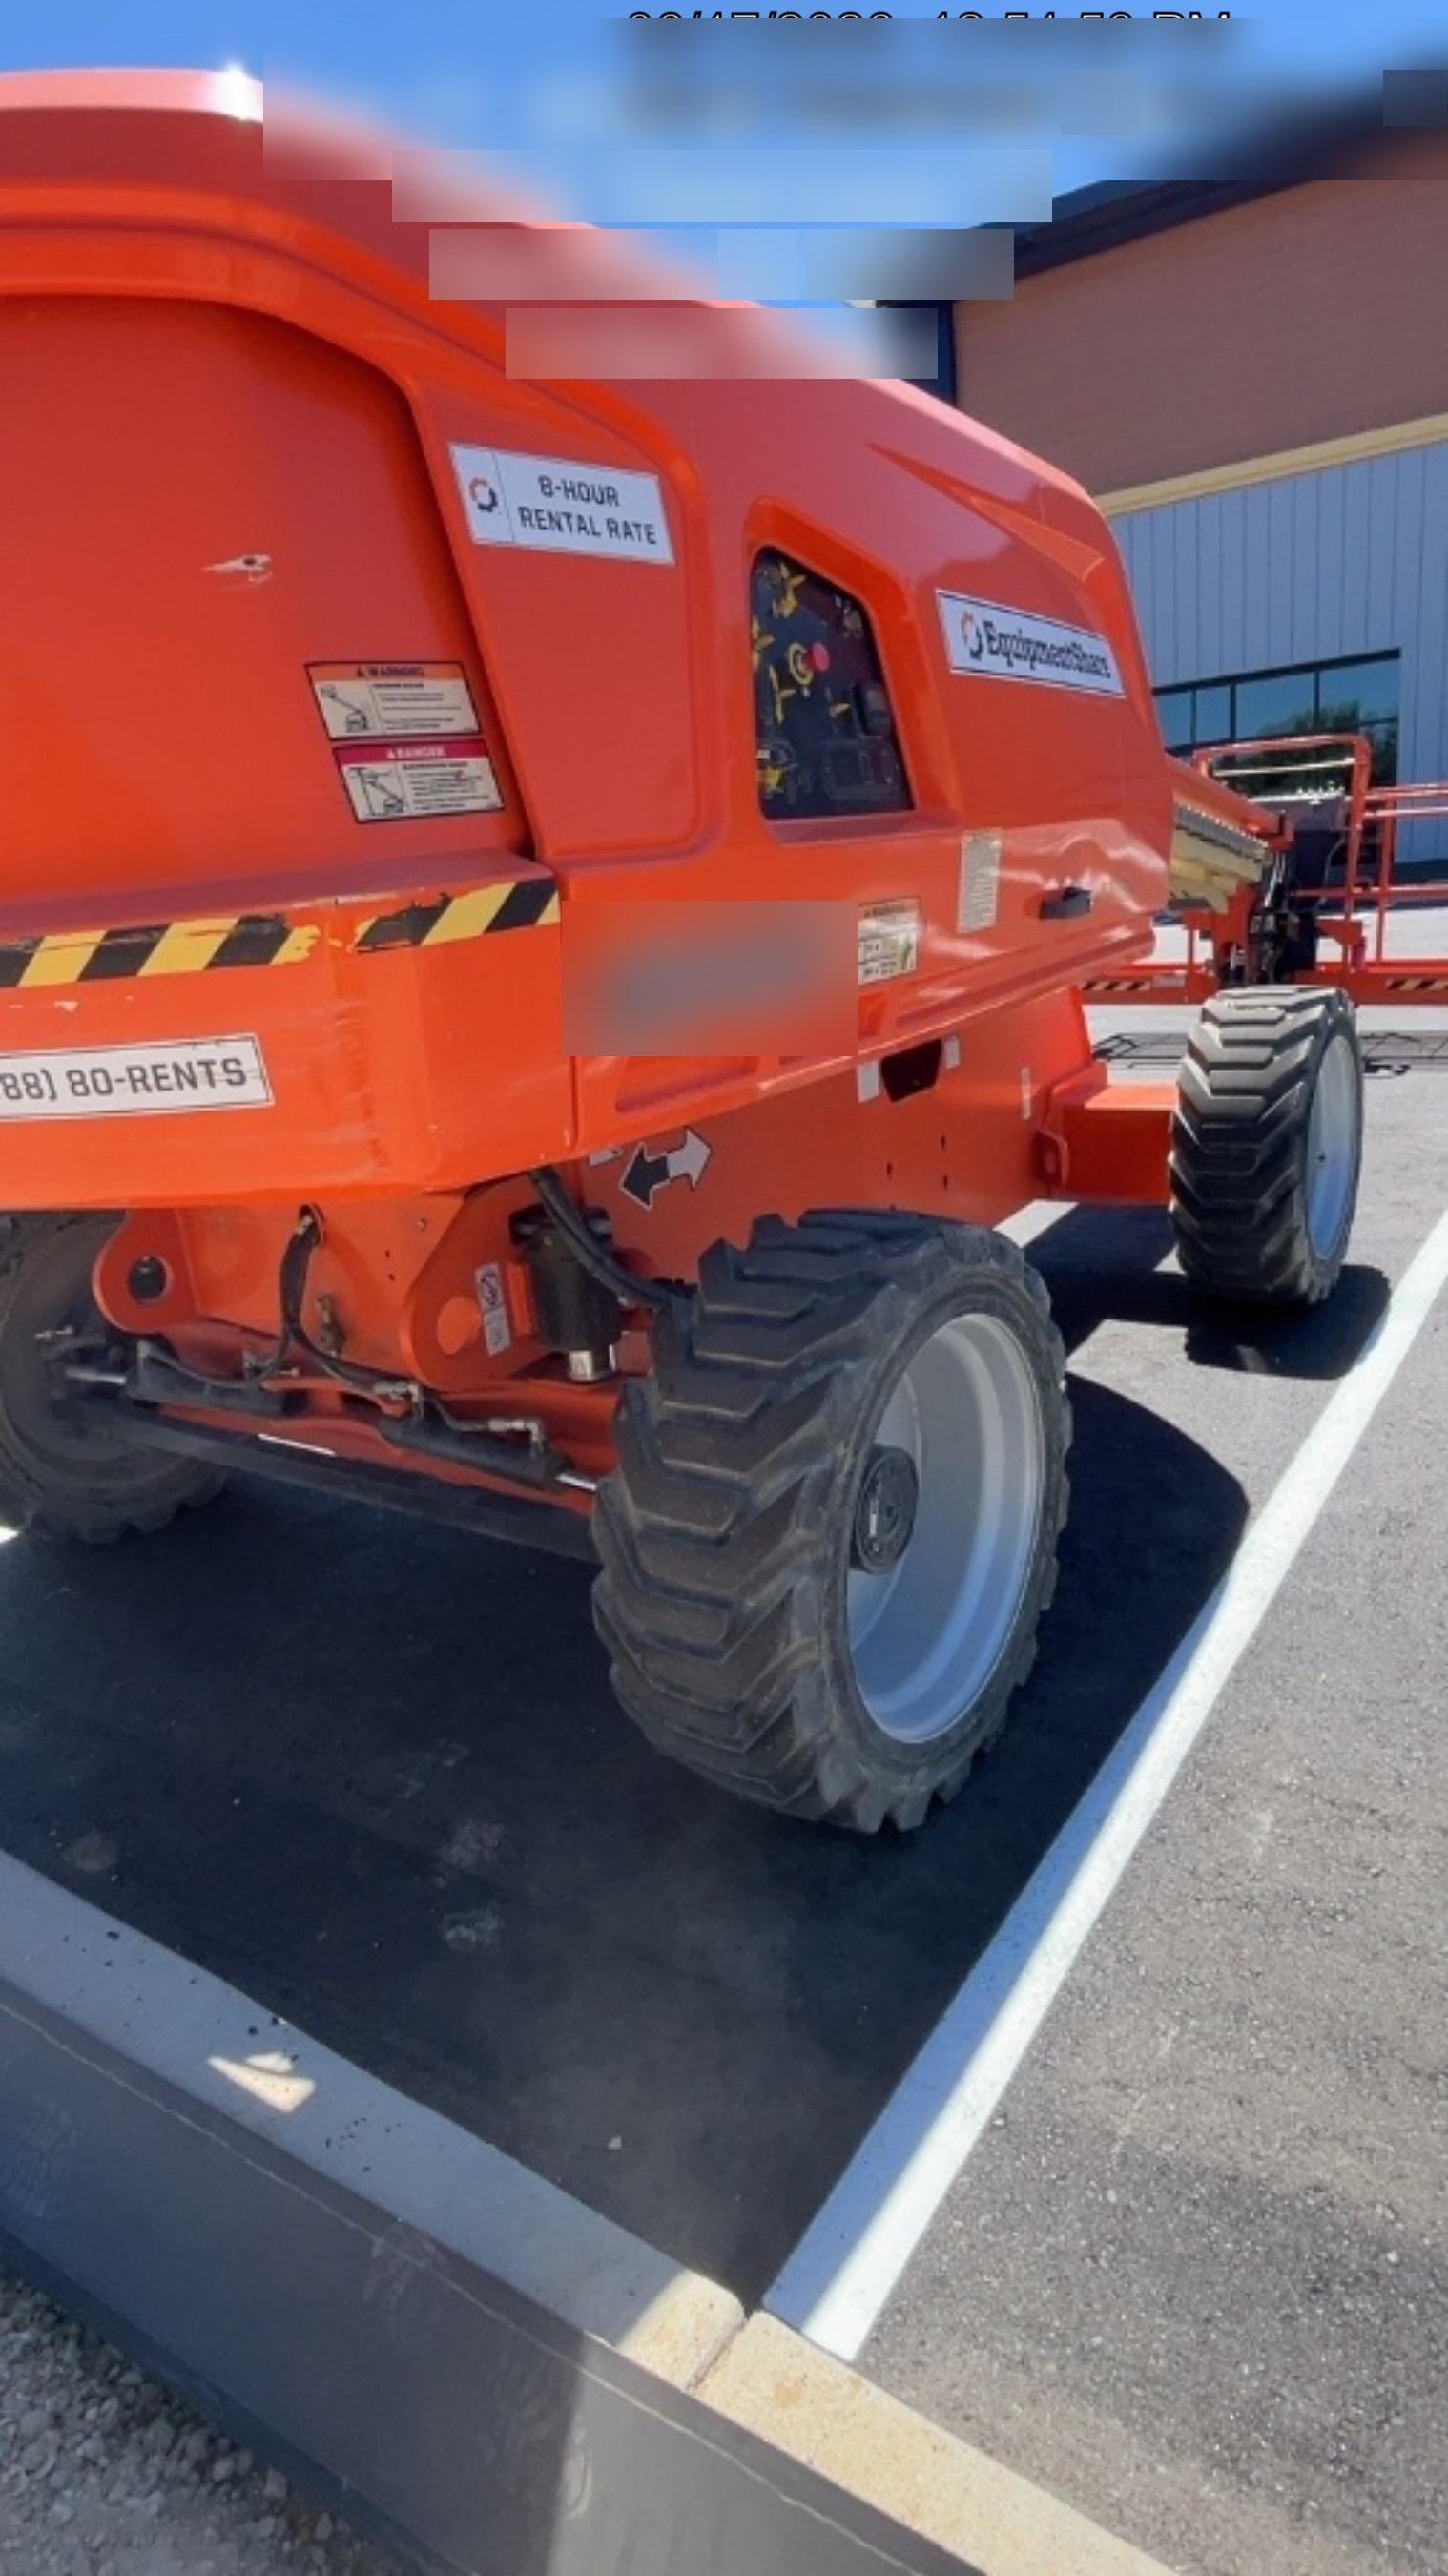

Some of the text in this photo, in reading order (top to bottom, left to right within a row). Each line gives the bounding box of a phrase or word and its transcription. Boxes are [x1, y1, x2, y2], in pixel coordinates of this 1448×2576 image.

[537, 474, 620, 508] 8-HOUR
[517, 505, 658, 545] RENTAL RATE
[66, 1057, 248, 1097] 80-RENTS
